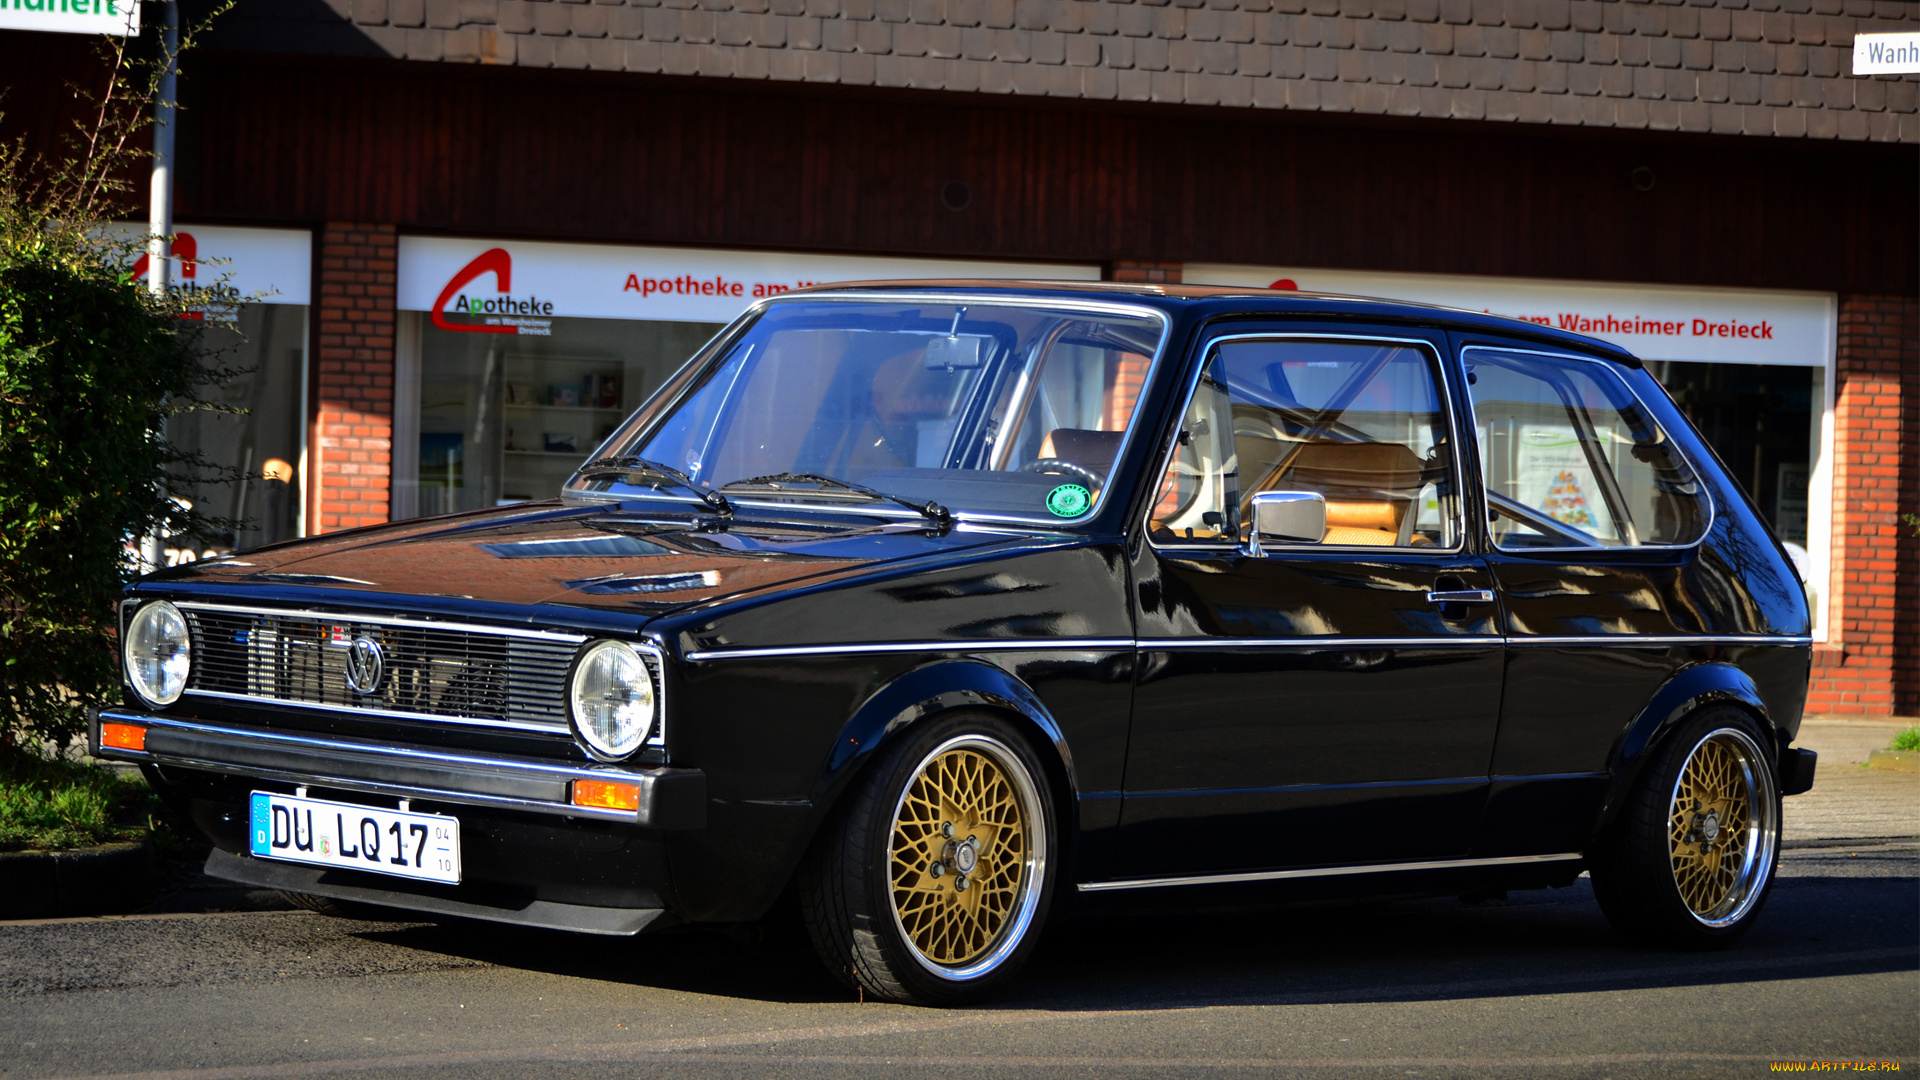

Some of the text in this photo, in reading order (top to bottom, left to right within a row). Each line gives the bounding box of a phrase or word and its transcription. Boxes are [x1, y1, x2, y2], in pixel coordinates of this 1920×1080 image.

[1869, 41, 1919, 63] Wanh
[623, 274, 789, 298] Apotheke am
[455, 294, 553, 317] Apotheke
[502, 318, 552, 327] Wanheimer
[518, 327, 552, 336] Dreieck
[1558, 313, 1685, 336] Wanheimer
[1692, 319, 1773, 339] Dreieck
[257, 830, 266, 844] D
[272, 804, 314, 852] DU
[436, 826, 449, 840] 04
[438, 859, 451, 872] 10
